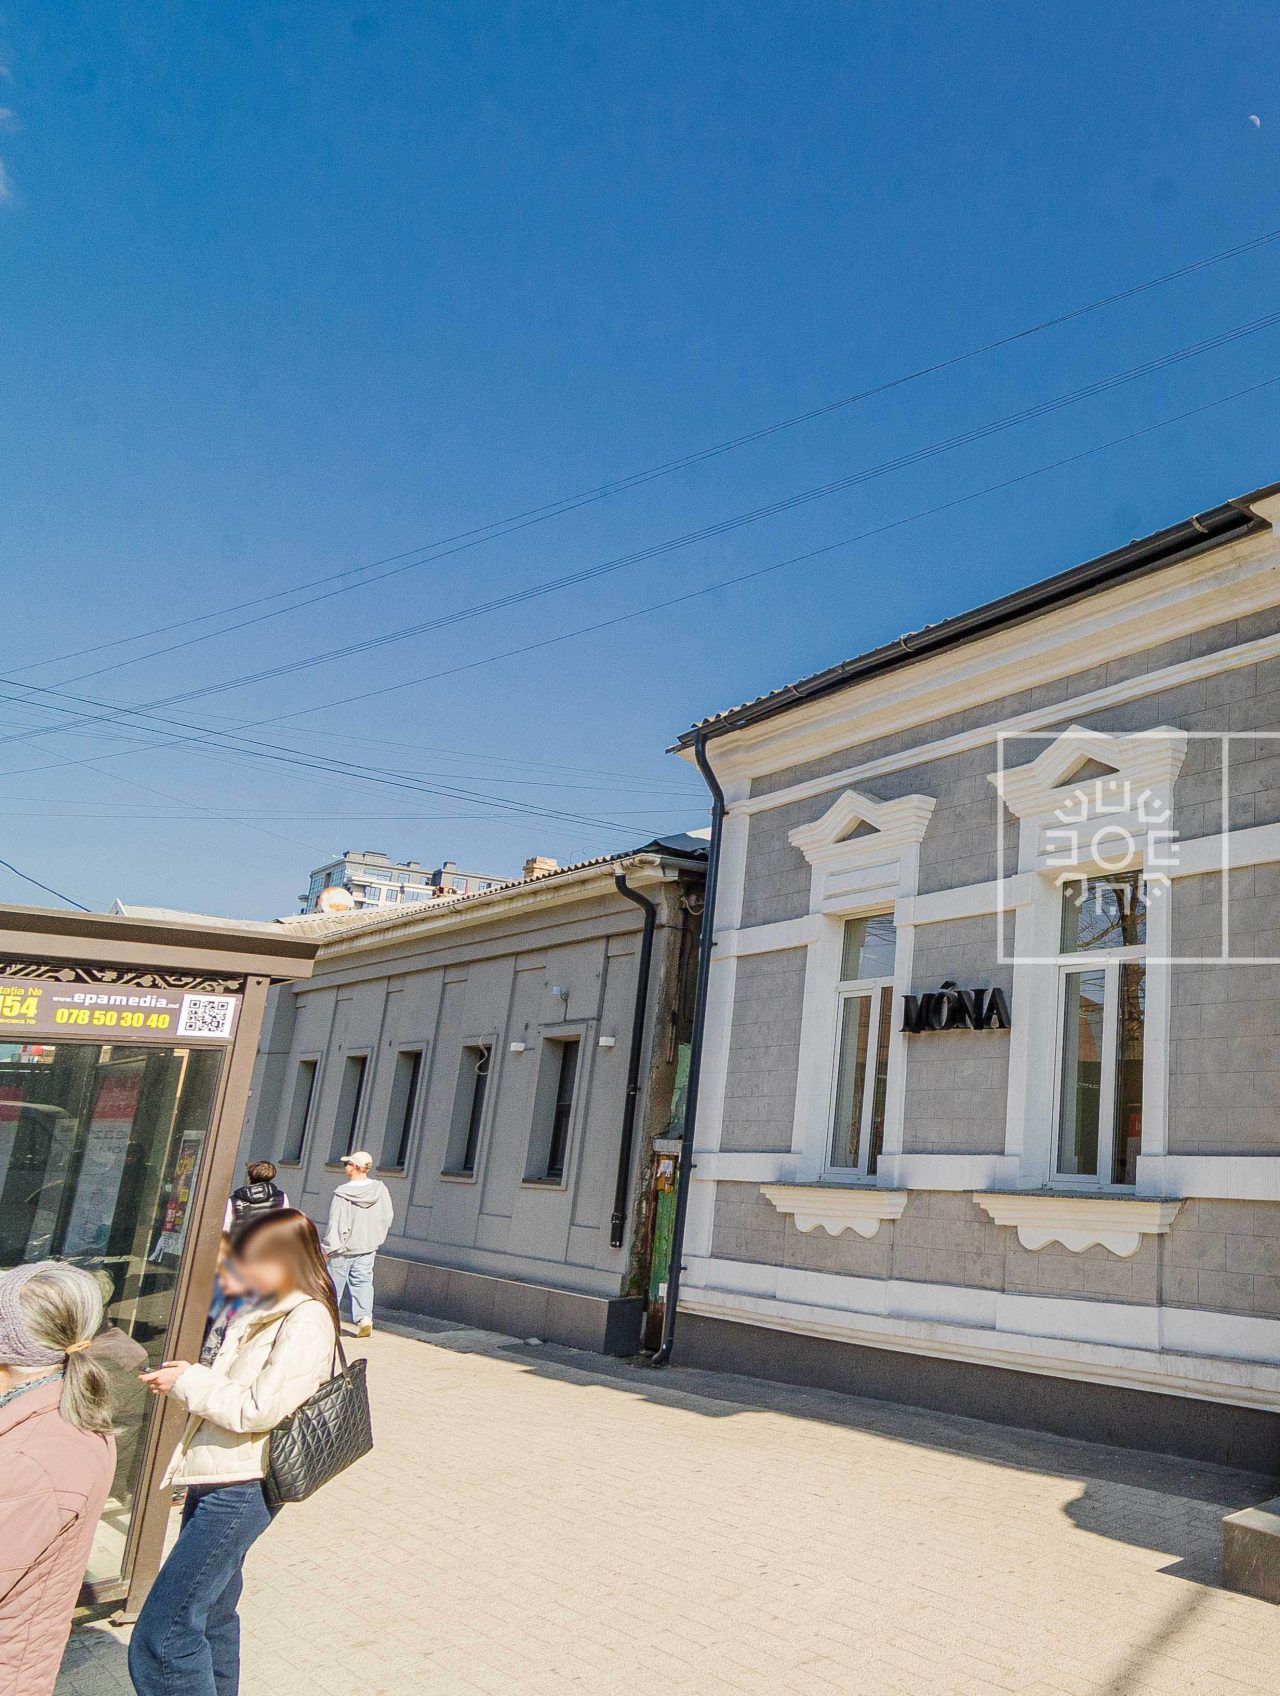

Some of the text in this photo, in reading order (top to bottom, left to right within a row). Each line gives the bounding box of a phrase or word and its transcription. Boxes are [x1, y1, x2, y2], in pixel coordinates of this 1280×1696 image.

[55, 1008, 170, 1029] 078 50 30 40
